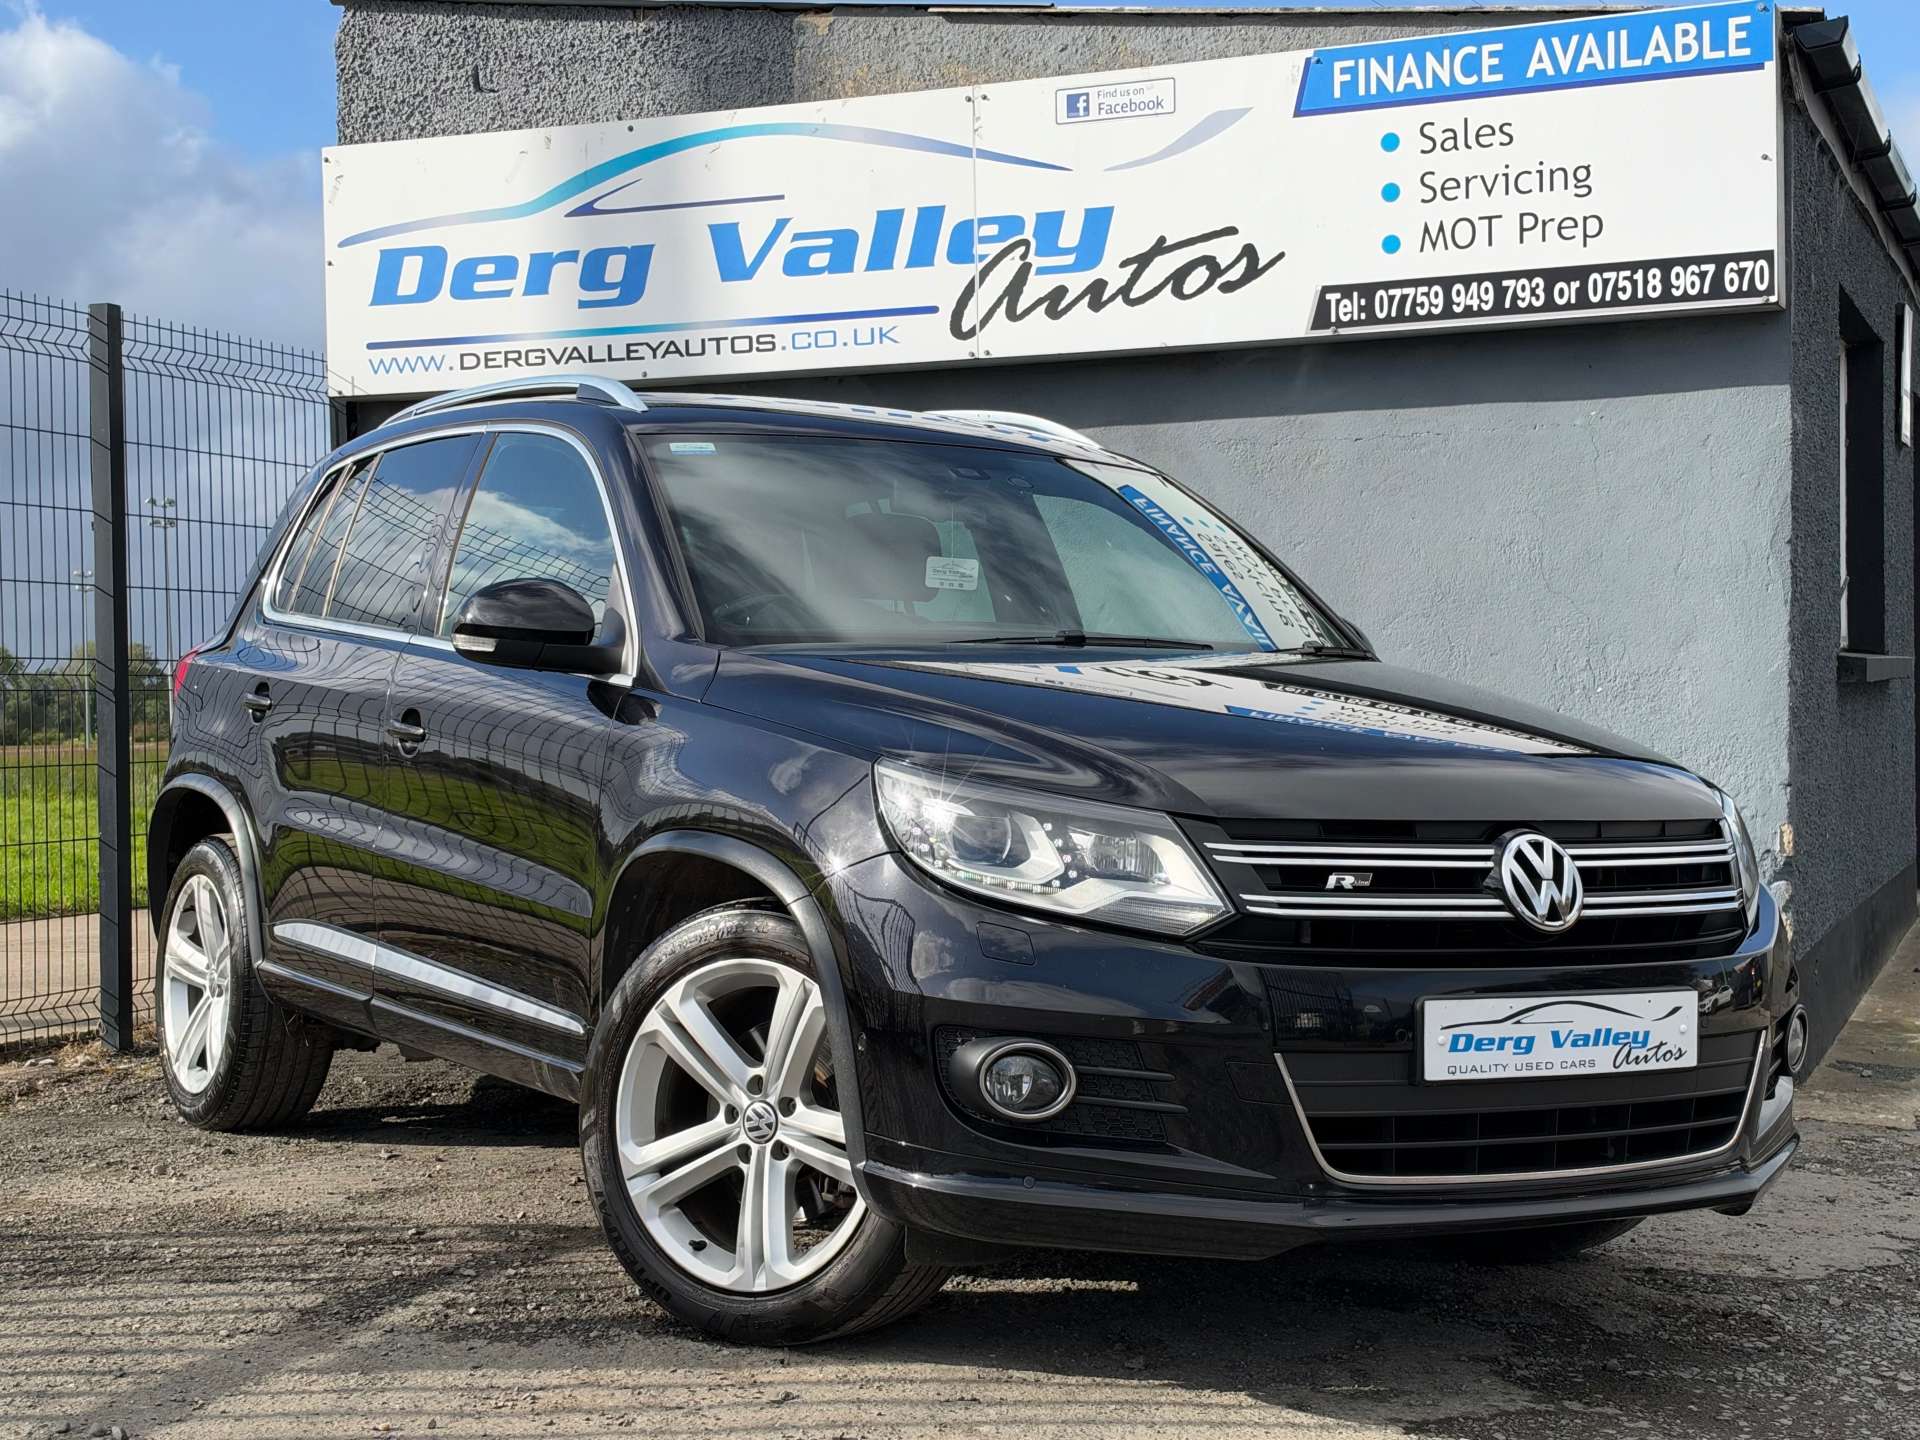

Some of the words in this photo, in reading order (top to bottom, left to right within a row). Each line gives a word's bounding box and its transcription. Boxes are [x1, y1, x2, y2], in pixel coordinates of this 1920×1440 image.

[1332, 42, 1504, 99] FINANCE
[1525, 15, 1753, 79] AVAILABLE
[1097, 88, 1118, 100] Find
[1119, 89, 1131, 97] us
[1132, 87, 1145, 96] on
[1098, 95, 1165, 116] Facebook
[1418, 117, 1515, 155] Sales
[1418, 160, 1594, 205] Servicing
[1418, 214, 1504, 254] MOT
[1517, 211, 1604, 248] Prep
[368, 243, 656, 310] Derg
[707, 204, 1116, 283] Valley
[949, 225, 1286, 341] Autos
[1325, 291, 1367, 324] Tel:
[1374, 284, 1442, 320] 07759
[1452, 281, 1495, 314] 949
[1501, 276, 1545, 310] 793
[1552, 280, 1580, 306] or
[1587, 269, 1660, 304] 07518
[1670, 263, 1715, 297] 967
[1723, 259, 1770, 293] 670
[1325, 875, 1355, 889] R
[1447, 1063, 1510, 1075] QUALITY
[1514, 1060, 1554, 1072] USED
[1560, 1058, 1596, 1069] CARS
[1448, 1033, 1536, 1056] Derg
[1550, 1028, 1650, 1050] Valley
[1612, 1040, 1688, 1070] Autos
